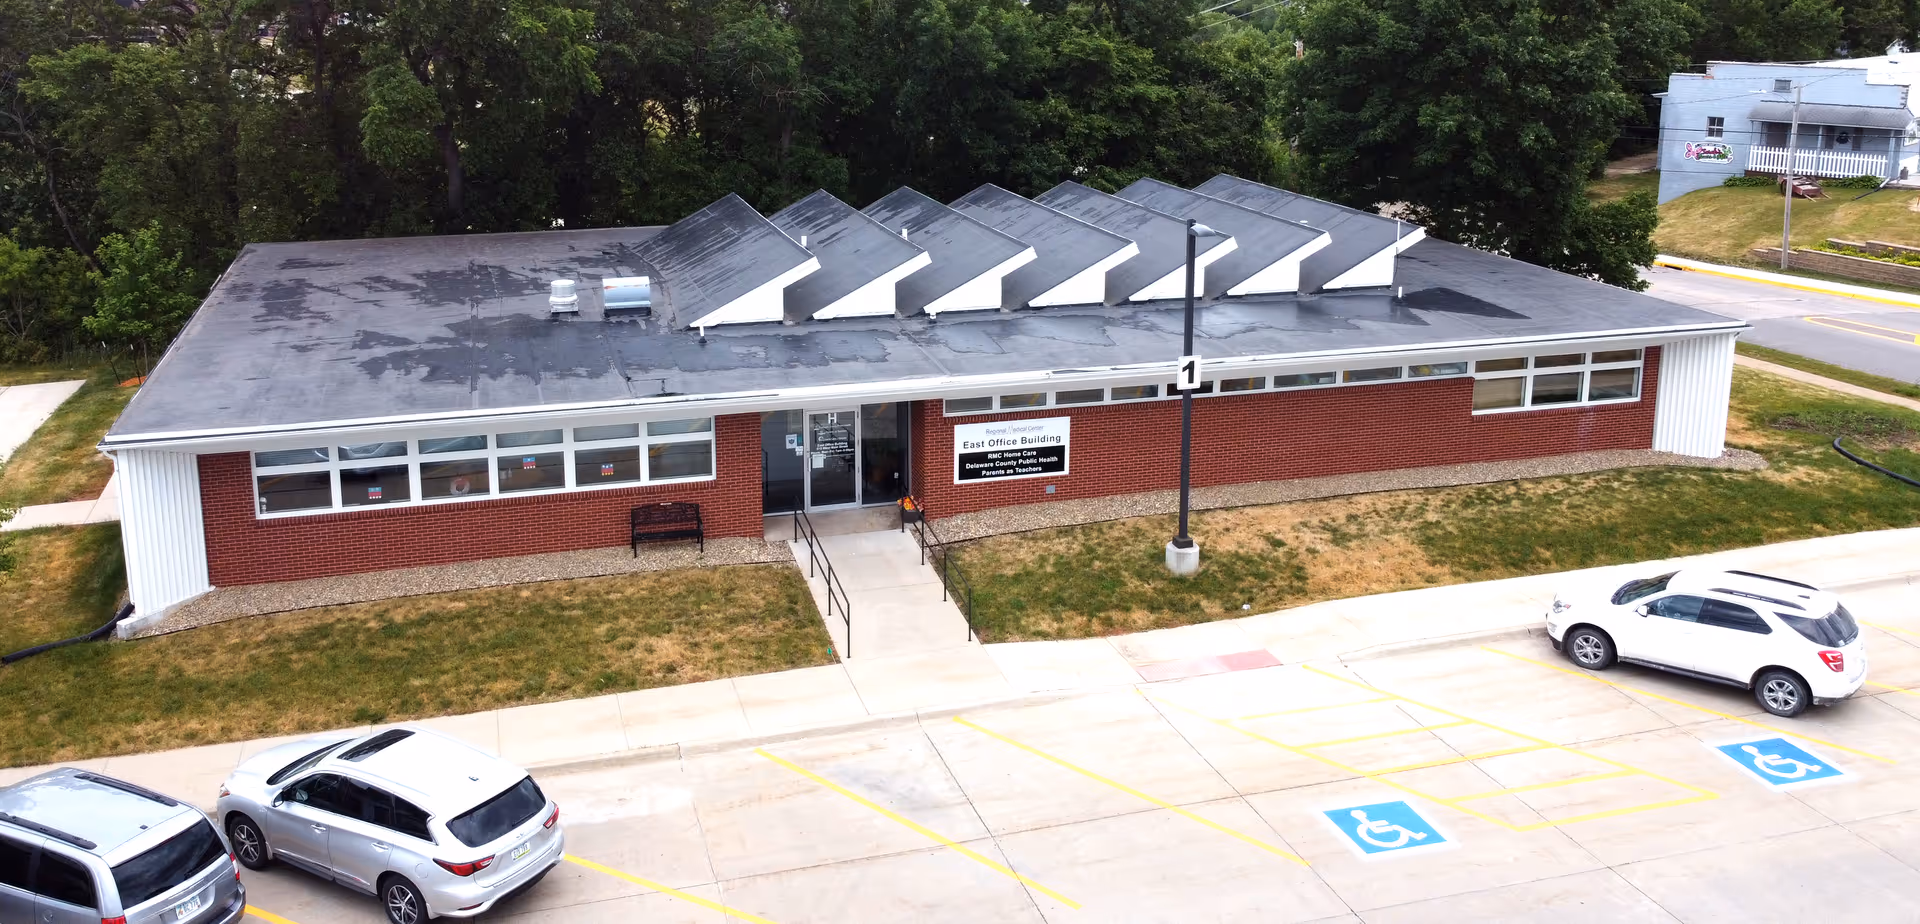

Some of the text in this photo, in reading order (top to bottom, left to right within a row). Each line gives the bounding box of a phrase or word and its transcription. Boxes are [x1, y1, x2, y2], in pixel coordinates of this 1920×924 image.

[1182, 360, 1195, 384] 1
[985, 428, 1007, 436] Regional
[963, 435, 1061, 449] East Office Building
[987, 452, 1002, 460] RMC
[995, 460, 1017, 468] County
[981, 469, 1005, 477] Parents
[1015, 466, 1042, 474] Teachers
